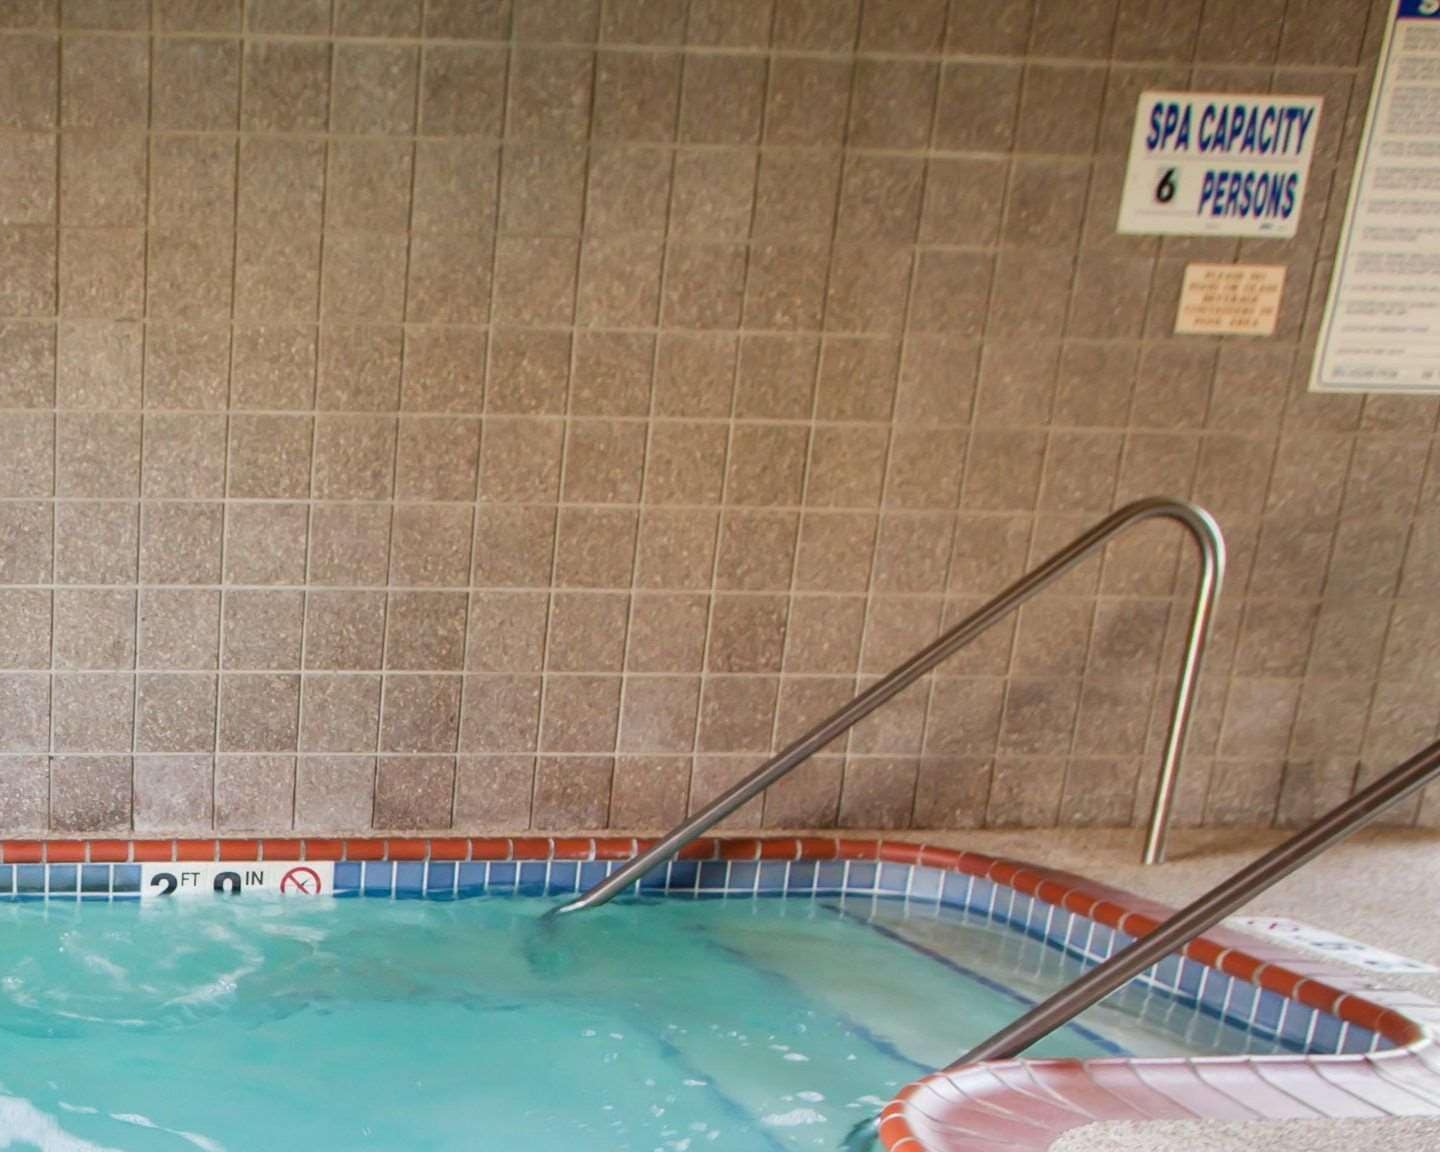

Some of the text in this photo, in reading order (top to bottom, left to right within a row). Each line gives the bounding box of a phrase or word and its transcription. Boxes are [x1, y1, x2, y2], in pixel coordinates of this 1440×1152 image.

[1146, 102, 1314, 155] SPA CAPACITY
[1156, 166, 1298, 219] 6 PERSONS
[150, 872, 178, 896] 2
[181, 872, 200, 886] FT
[245, 871, 264, 886] IN
